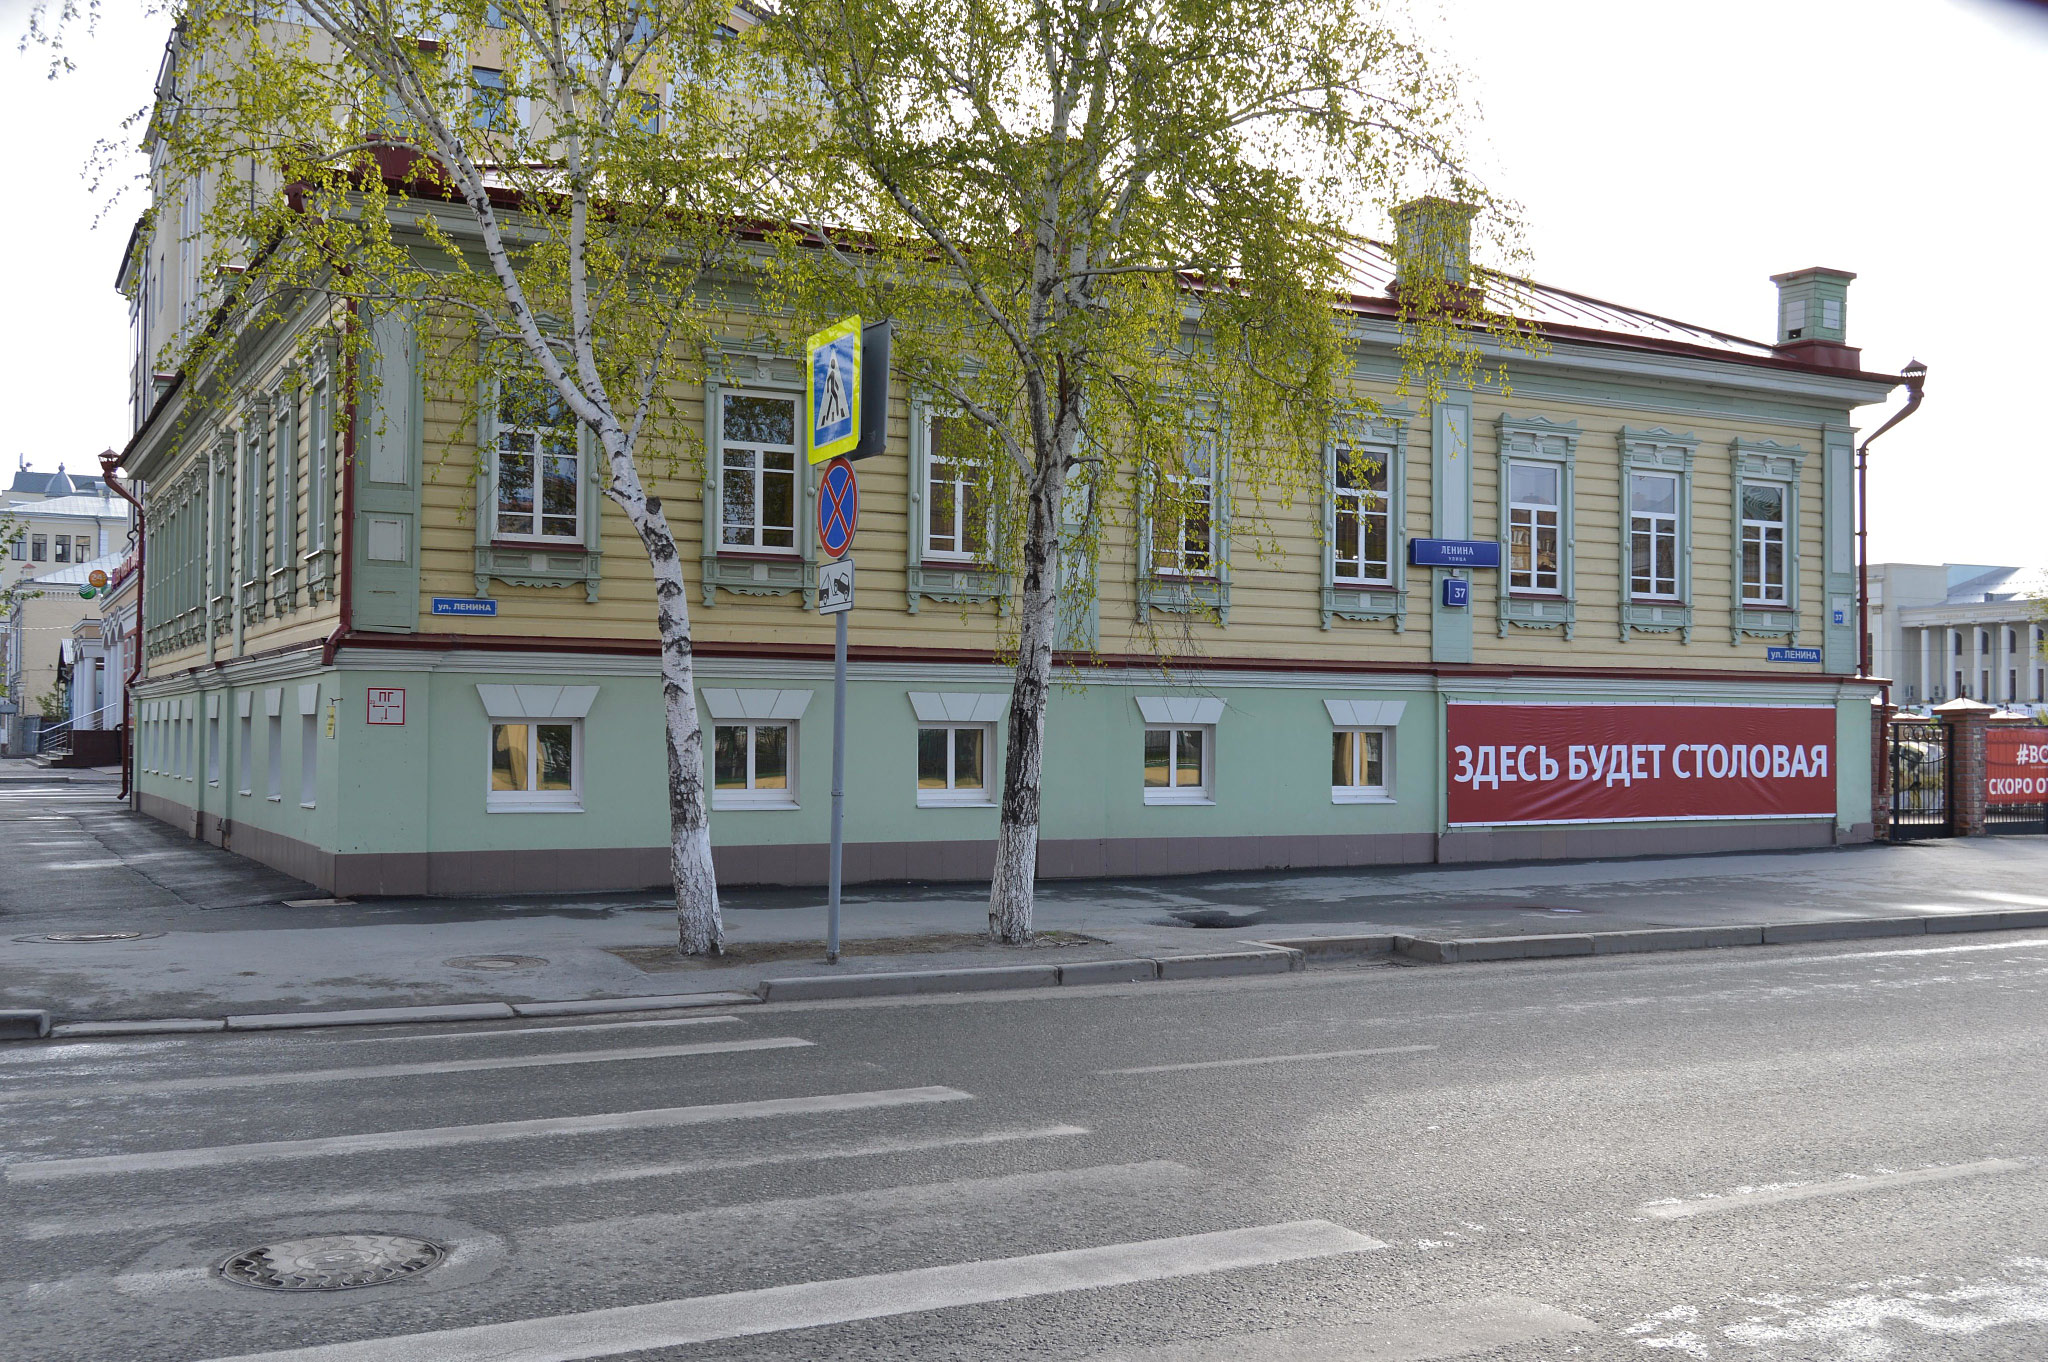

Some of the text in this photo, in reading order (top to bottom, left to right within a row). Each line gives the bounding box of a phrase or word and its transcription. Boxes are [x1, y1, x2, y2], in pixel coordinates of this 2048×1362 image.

[1441, 545, 1474, 556] ЛЕНИНА
[1454, 587, 1466, 598] 37
[453, 603, 492, 611] ЛЕНИНА
[1770, 650, 1818, 660] ул. ЛЕНИНА
[379, 691, 394, 702] ПГ
[1454, 743, 1828, 790] ЗДЕСЬ БУДЕТ СТОЛОВАЯ
[1988, 777, 2032, 795] СКОРО
